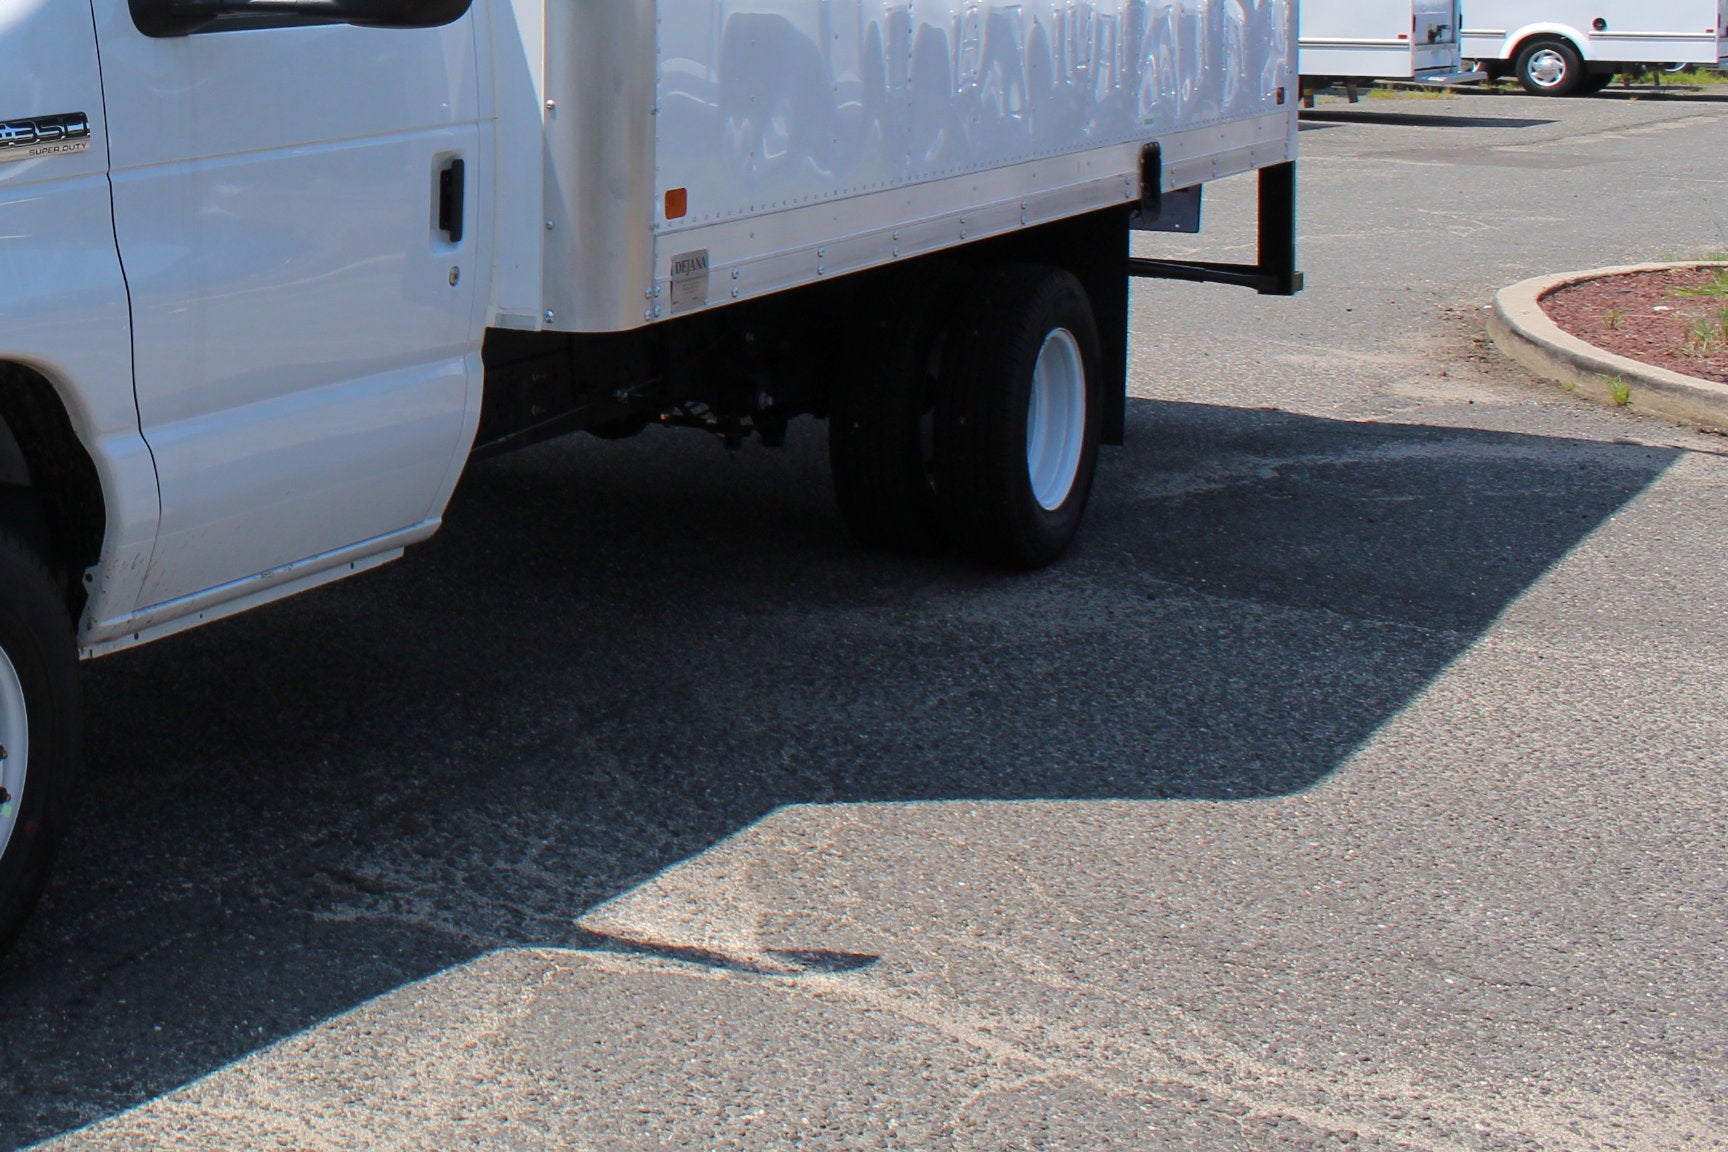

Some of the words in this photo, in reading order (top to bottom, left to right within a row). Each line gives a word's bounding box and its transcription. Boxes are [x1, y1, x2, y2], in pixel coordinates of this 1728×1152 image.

[28, 146, 60, 157] SUPER
[62, 142, 87, 152] DUTY
[674, 256, 708, 276] DEJANA
